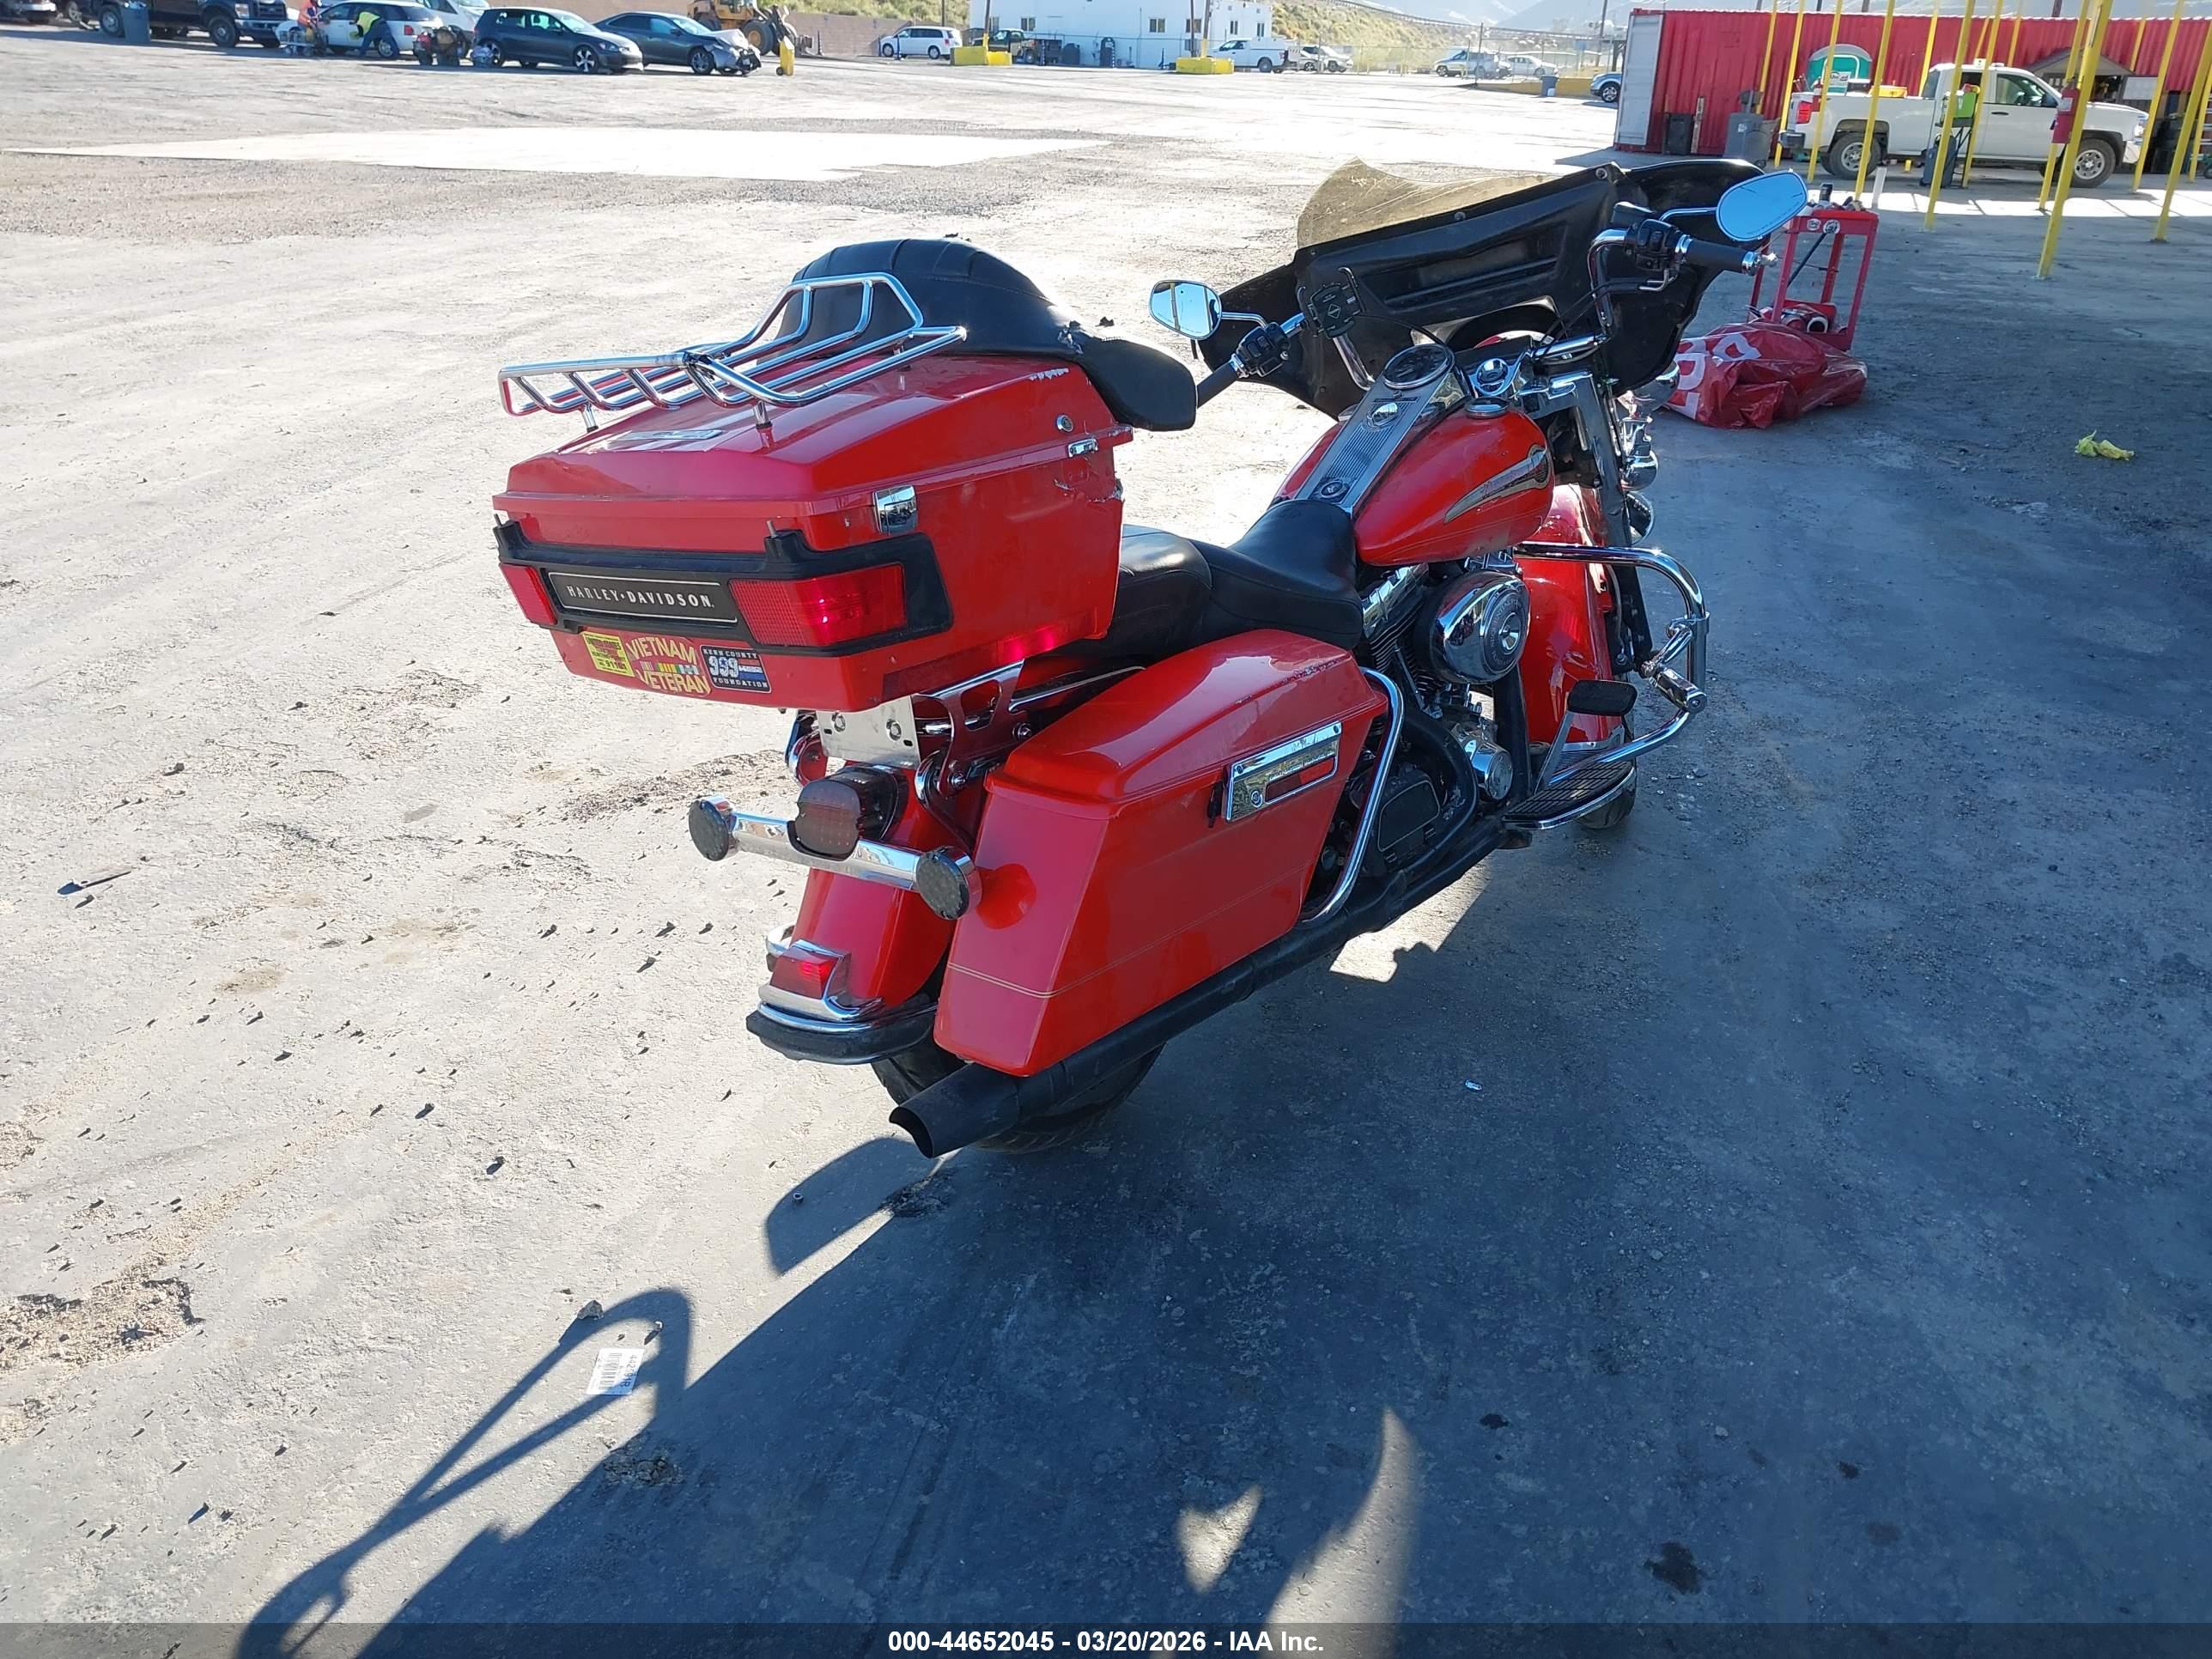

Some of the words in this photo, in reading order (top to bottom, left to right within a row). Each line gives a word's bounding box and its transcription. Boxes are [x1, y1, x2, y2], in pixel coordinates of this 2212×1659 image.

[626, 636, 698, 665] VIETNAM
[703, 648, 724, 657] KERN
[726, 651, 758, 659] COUNTY
[708, 656, 738, 678] 999
[635, 669, 711, 694] VETERAN
[713, 677, 769, 688] FOUNDATION
